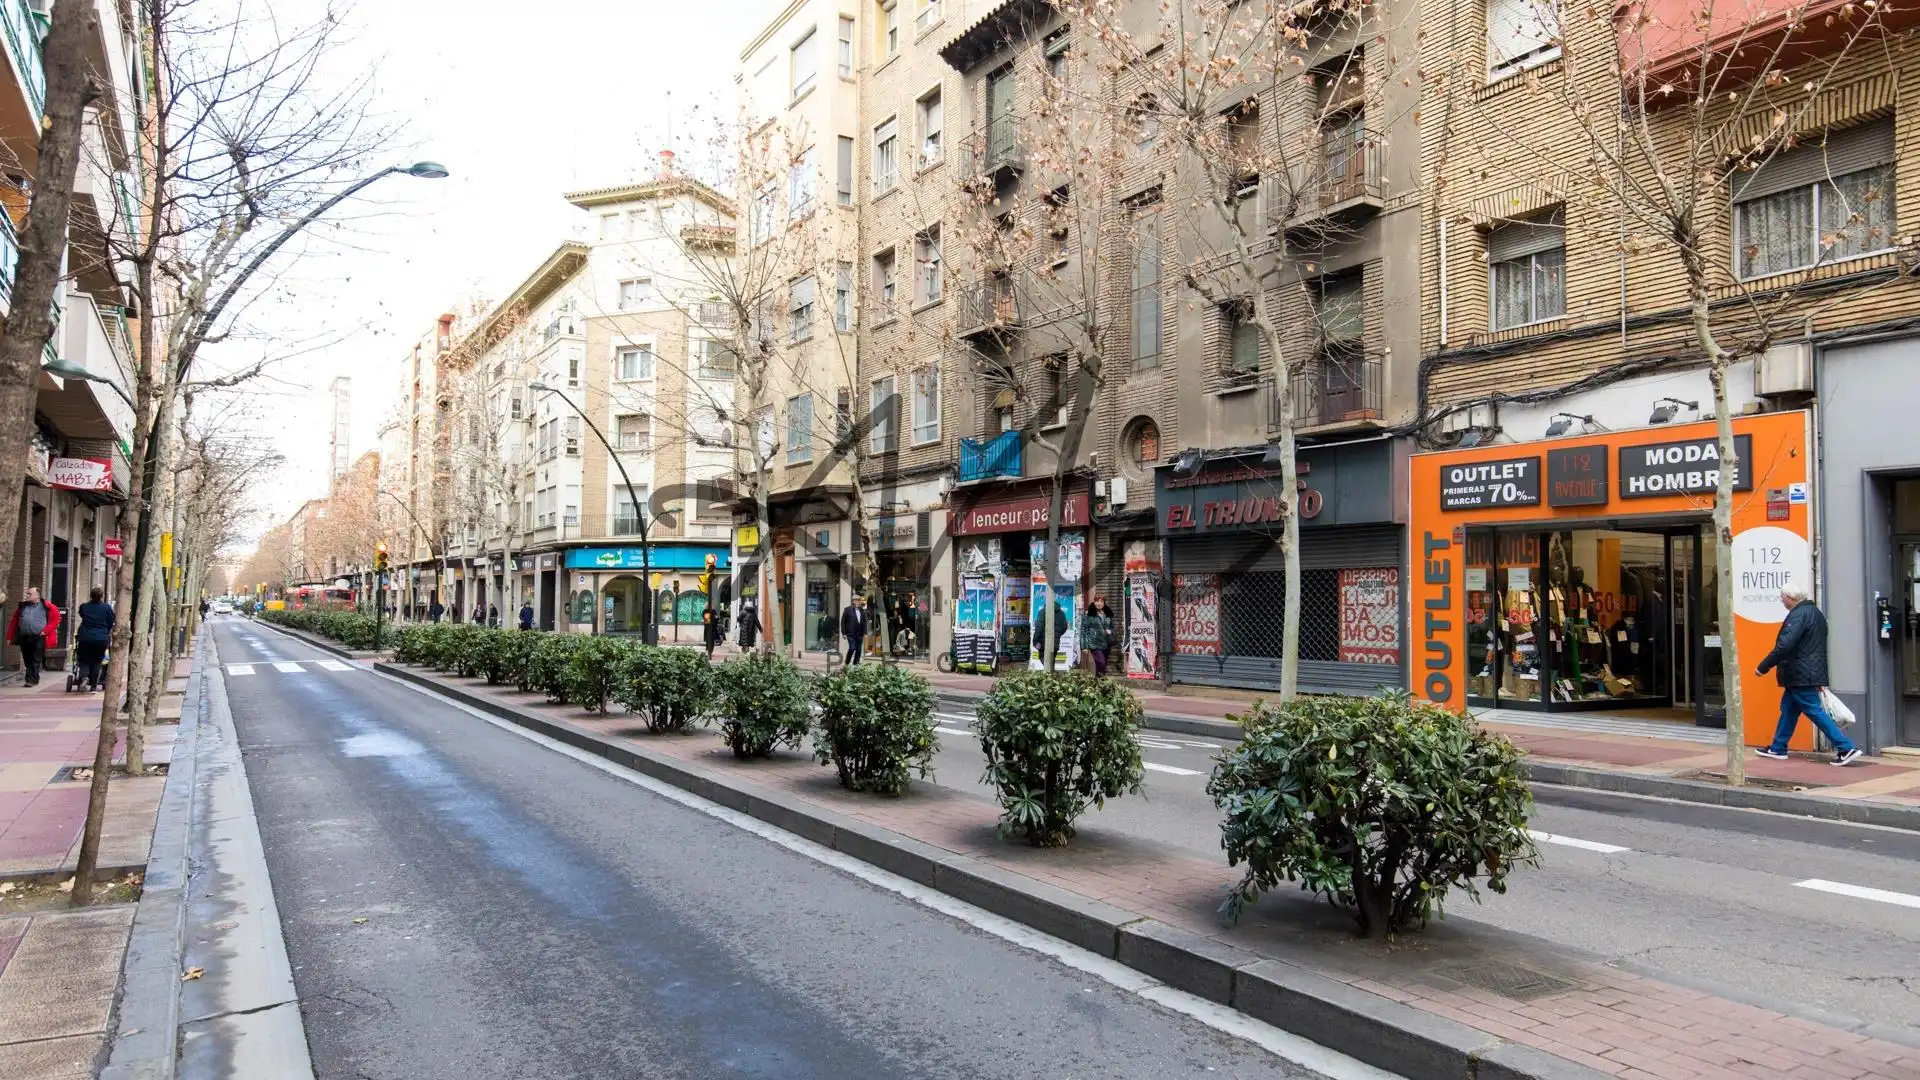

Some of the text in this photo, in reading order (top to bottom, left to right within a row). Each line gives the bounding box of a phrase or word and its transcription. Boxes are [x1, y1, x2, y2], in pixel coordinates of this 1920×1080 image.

[1562, 454, 1592, 473] 112
[1645, 443, 1720, 466] MODA
[55, 472, 93, 485] MABI
[1450, 462, 1527, 483] OUTLET
[1443, 485, 1485, 496] PRIMERAS
[1555, 478, 1598, 498] AVENUE
[1166, 488, 1323, 529] EL TRIUNO
[1447, 497, 1481, 506] MARCAS
[1748, 547, 1782, 565] 112
[1177, 606, 1198, 620] DA
[1344, 607, 1372, 624] DA
[1424, 531, 1452, 702] OUTLET
[1177, 621, 1216, 636] MOS
[1343, 624, 1396, 643] MOS
